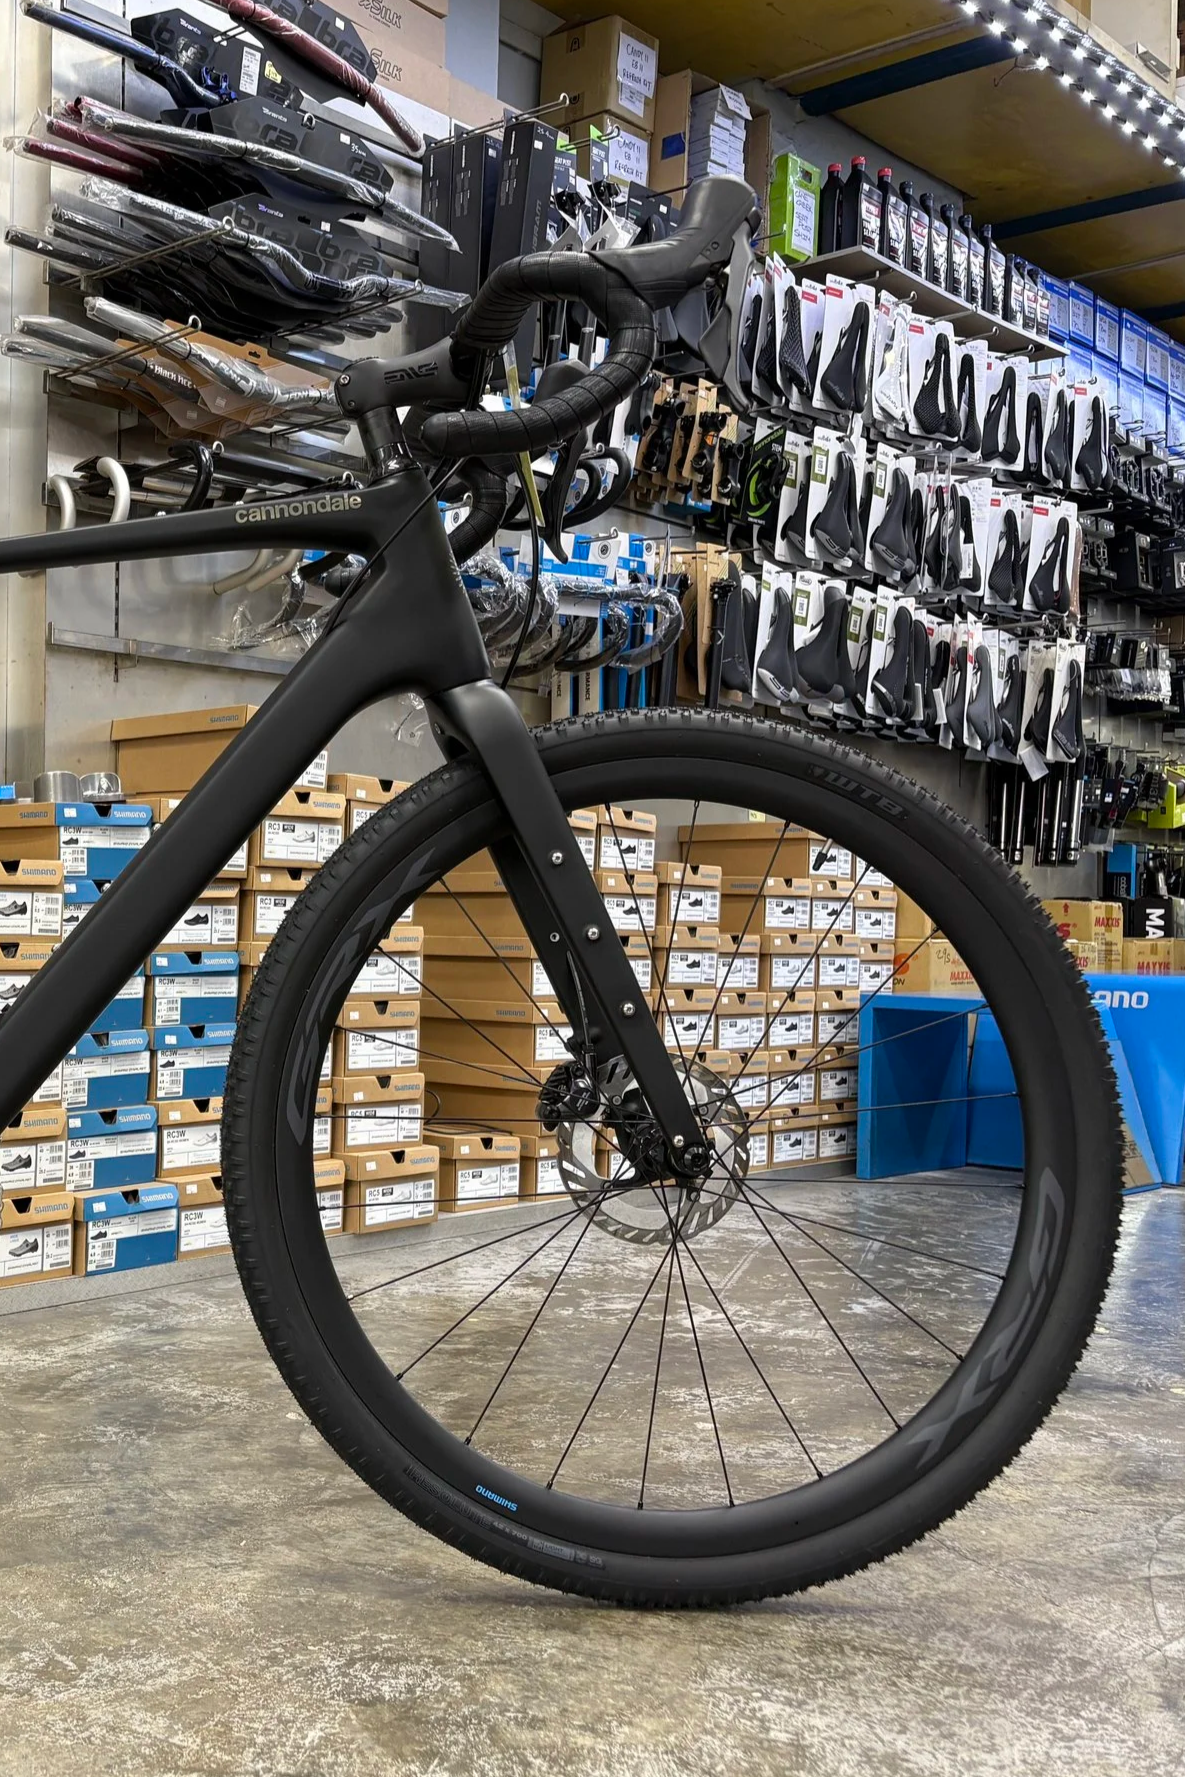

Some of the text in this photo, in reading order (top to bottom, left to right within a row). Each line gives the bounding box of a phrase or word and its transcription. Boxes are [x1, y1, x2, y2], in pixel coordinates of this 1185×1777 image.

[234, 491, 363, 524] cannondale
[209, 713, 240, 724] SHIMANO
[313, 801, 341, 809] SHIMANO
[19, 811, 49, 819] SHIMANO
[268, 822, 280, 830] RC3
[22, 868, 57, 876] SHIMANO
[1094, 917, 1120, 928] MAXXIS
[111, 1037, 144, 1046] SHIMANO
[352, 1034, 363, 1042] RC5
[65, 1057, 84, 1065] RC3W
[394, 1084, 420, 1092] SHIMANO
[23, 1117, 59, 1128] SHIMANO
[119, 1114, 151, 1123] SHIMANO
[167, 1130, 186, 1139] RC3W
[70, 1139, 89, 1147] RC3W
[410, 1156, 436, 1166] SHIMANO
[141, 1192, 174, 1203] SHIMANO
[369, 1189, 380, 1197] RC5
[34, 1203, 69, 1214] SHIMANO
[184, 1211, 204, 1221] RC3W
[92, 1219, 111, 1228] RC3W
[475, 1484, 518, 1512] SHIMANO
